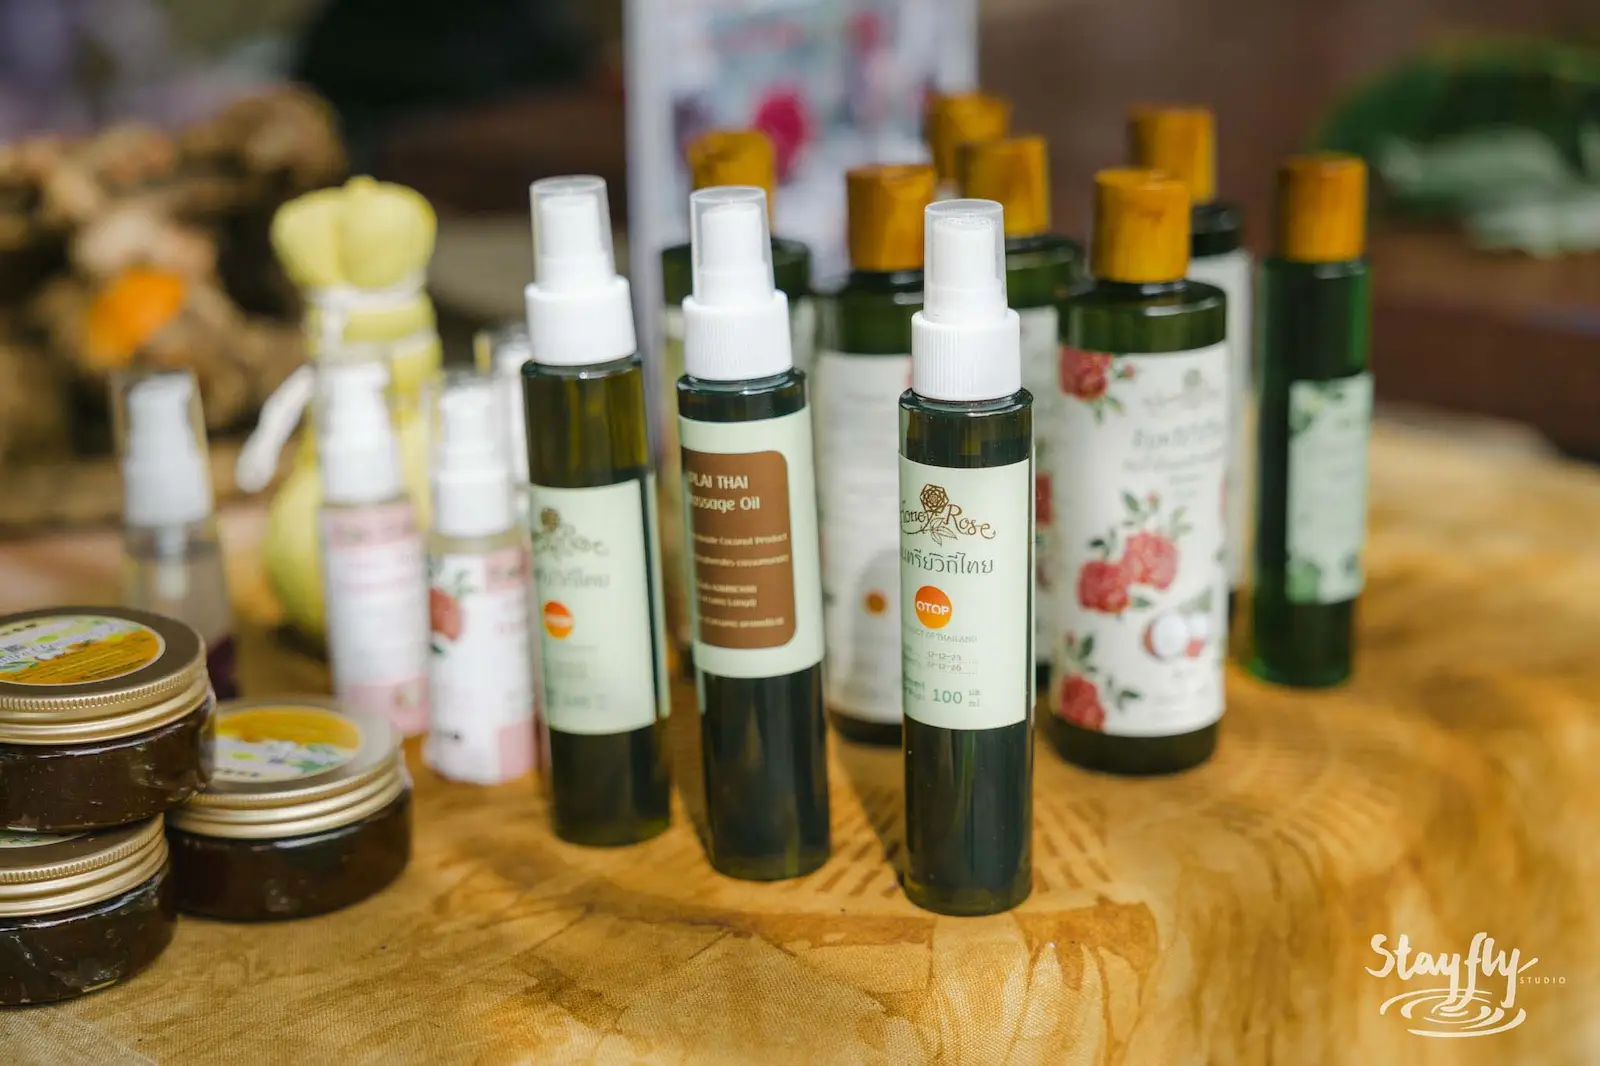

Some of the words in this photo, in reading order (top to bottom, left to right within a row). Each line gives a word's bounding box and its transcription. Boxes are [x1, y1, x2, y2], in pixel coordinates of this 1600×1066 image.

[716, 474, 749, 490] THAI
[740, 495, 760, 511] Oil
[945, 503, 997, 540] Rose
[916, 600, 950, 616] OTOP
[936, 633, 978, 643] THAILAND
[931, 688, 963, 704] 100
